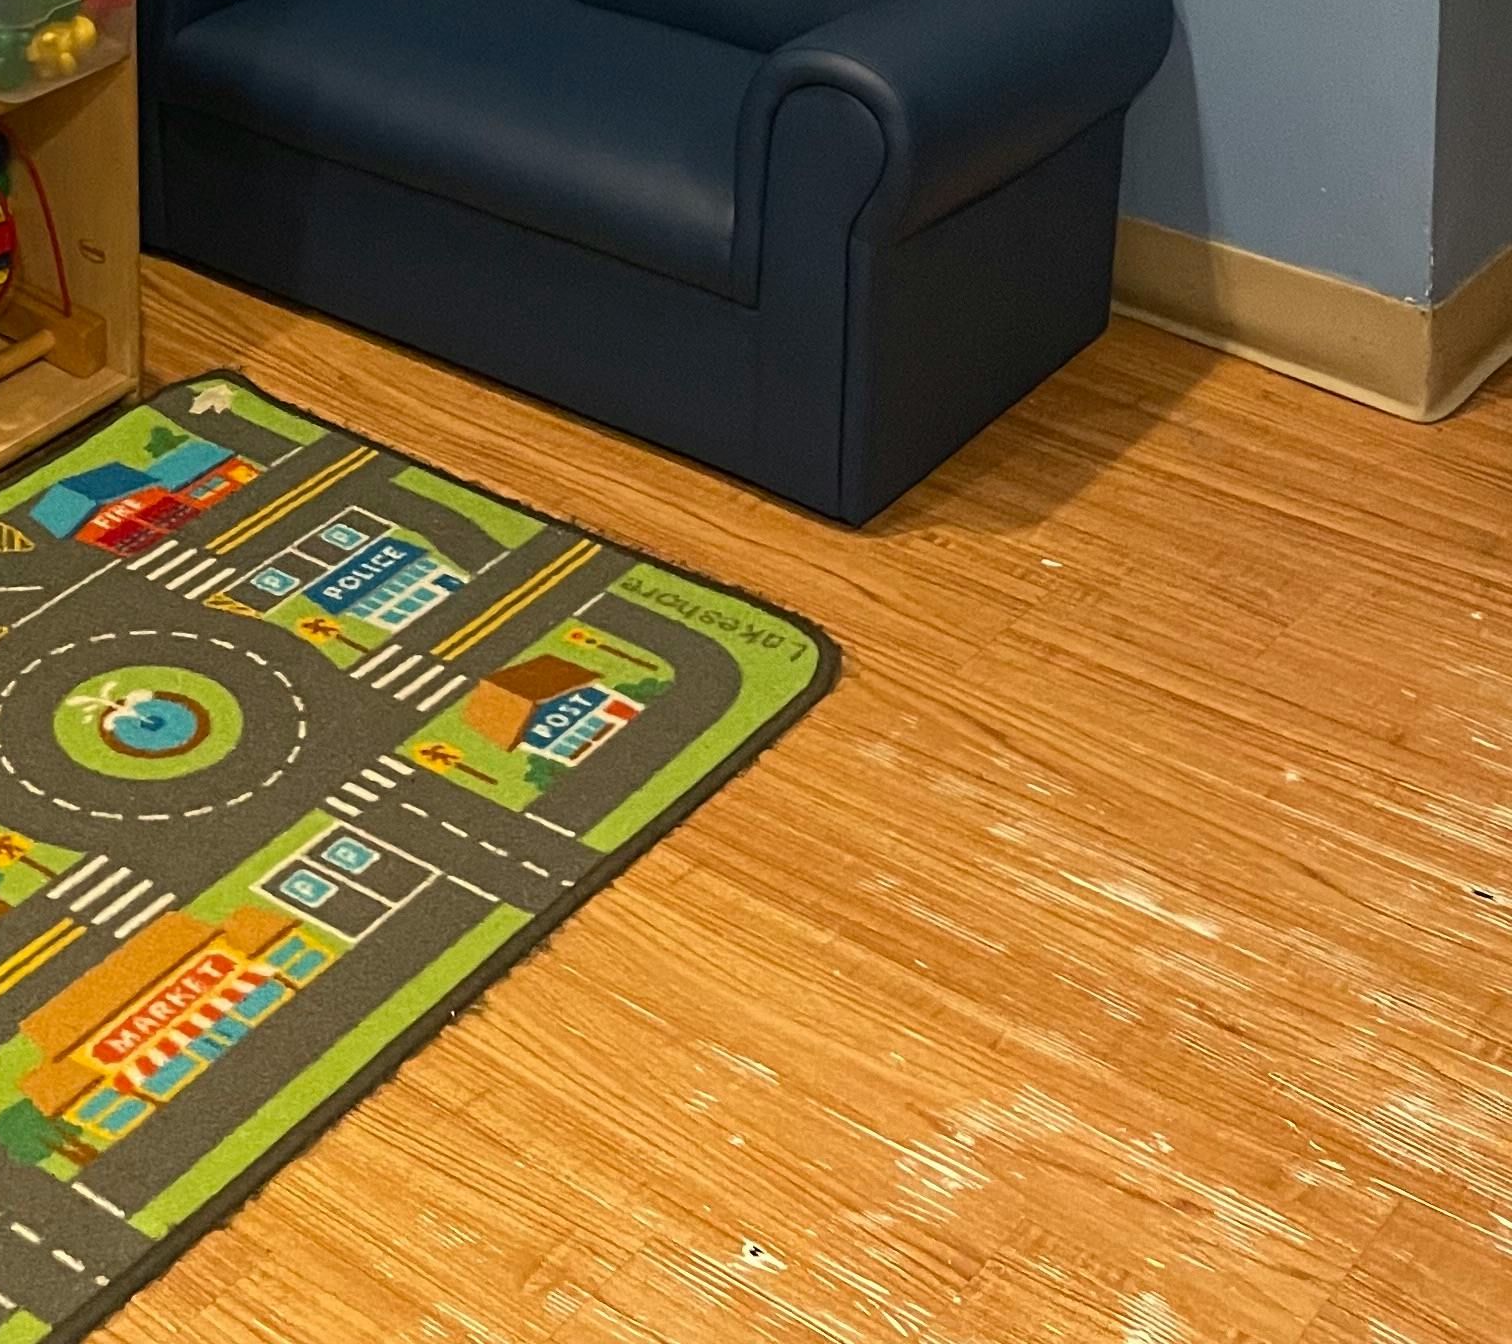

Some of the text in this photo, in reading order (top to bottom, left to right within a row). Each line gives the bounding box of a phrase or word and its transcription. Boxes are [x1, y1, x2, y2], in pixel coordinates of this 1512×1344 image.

[93, 498, 143, 530] FIRE
[322, 546, 407, 602] POLICE
[620, 577, 808, 662] Lakeshore
[532, 693, 595, 740] POST
[106, 961, 226, 1056] MARKET
